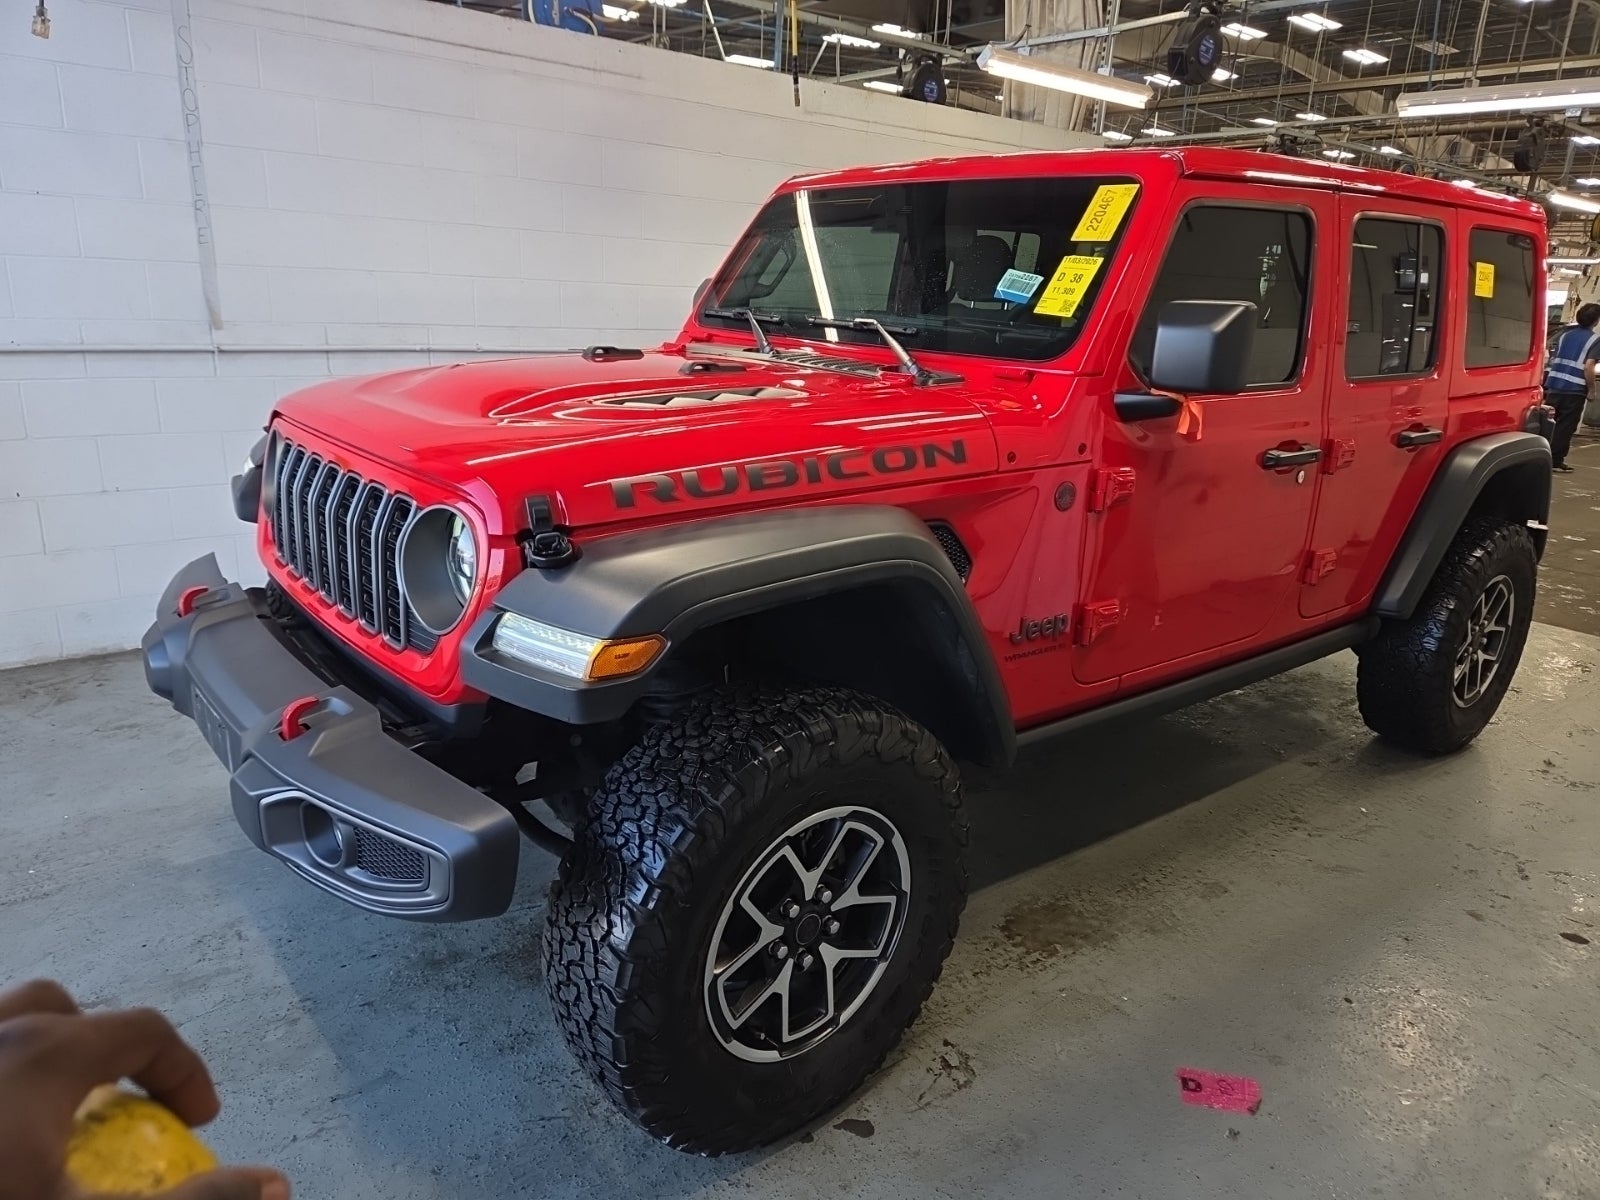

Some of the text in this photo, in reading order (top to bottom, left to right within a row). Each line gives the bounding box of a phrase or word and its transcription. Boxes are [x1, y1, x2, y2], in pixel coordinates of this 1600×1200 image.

[177, 25, 209, 245] STOP HERE
[1086, 189, 1118, 232] 220467
[1057, 272, 1084, 284] D 38
[609, 439, 968, 509] RUBICON
[1009, 613, 1068, 646] Jeep
[1004, 645, 1057, 663] WRANGLER
[1181, 1076, 1203, 1093] D
